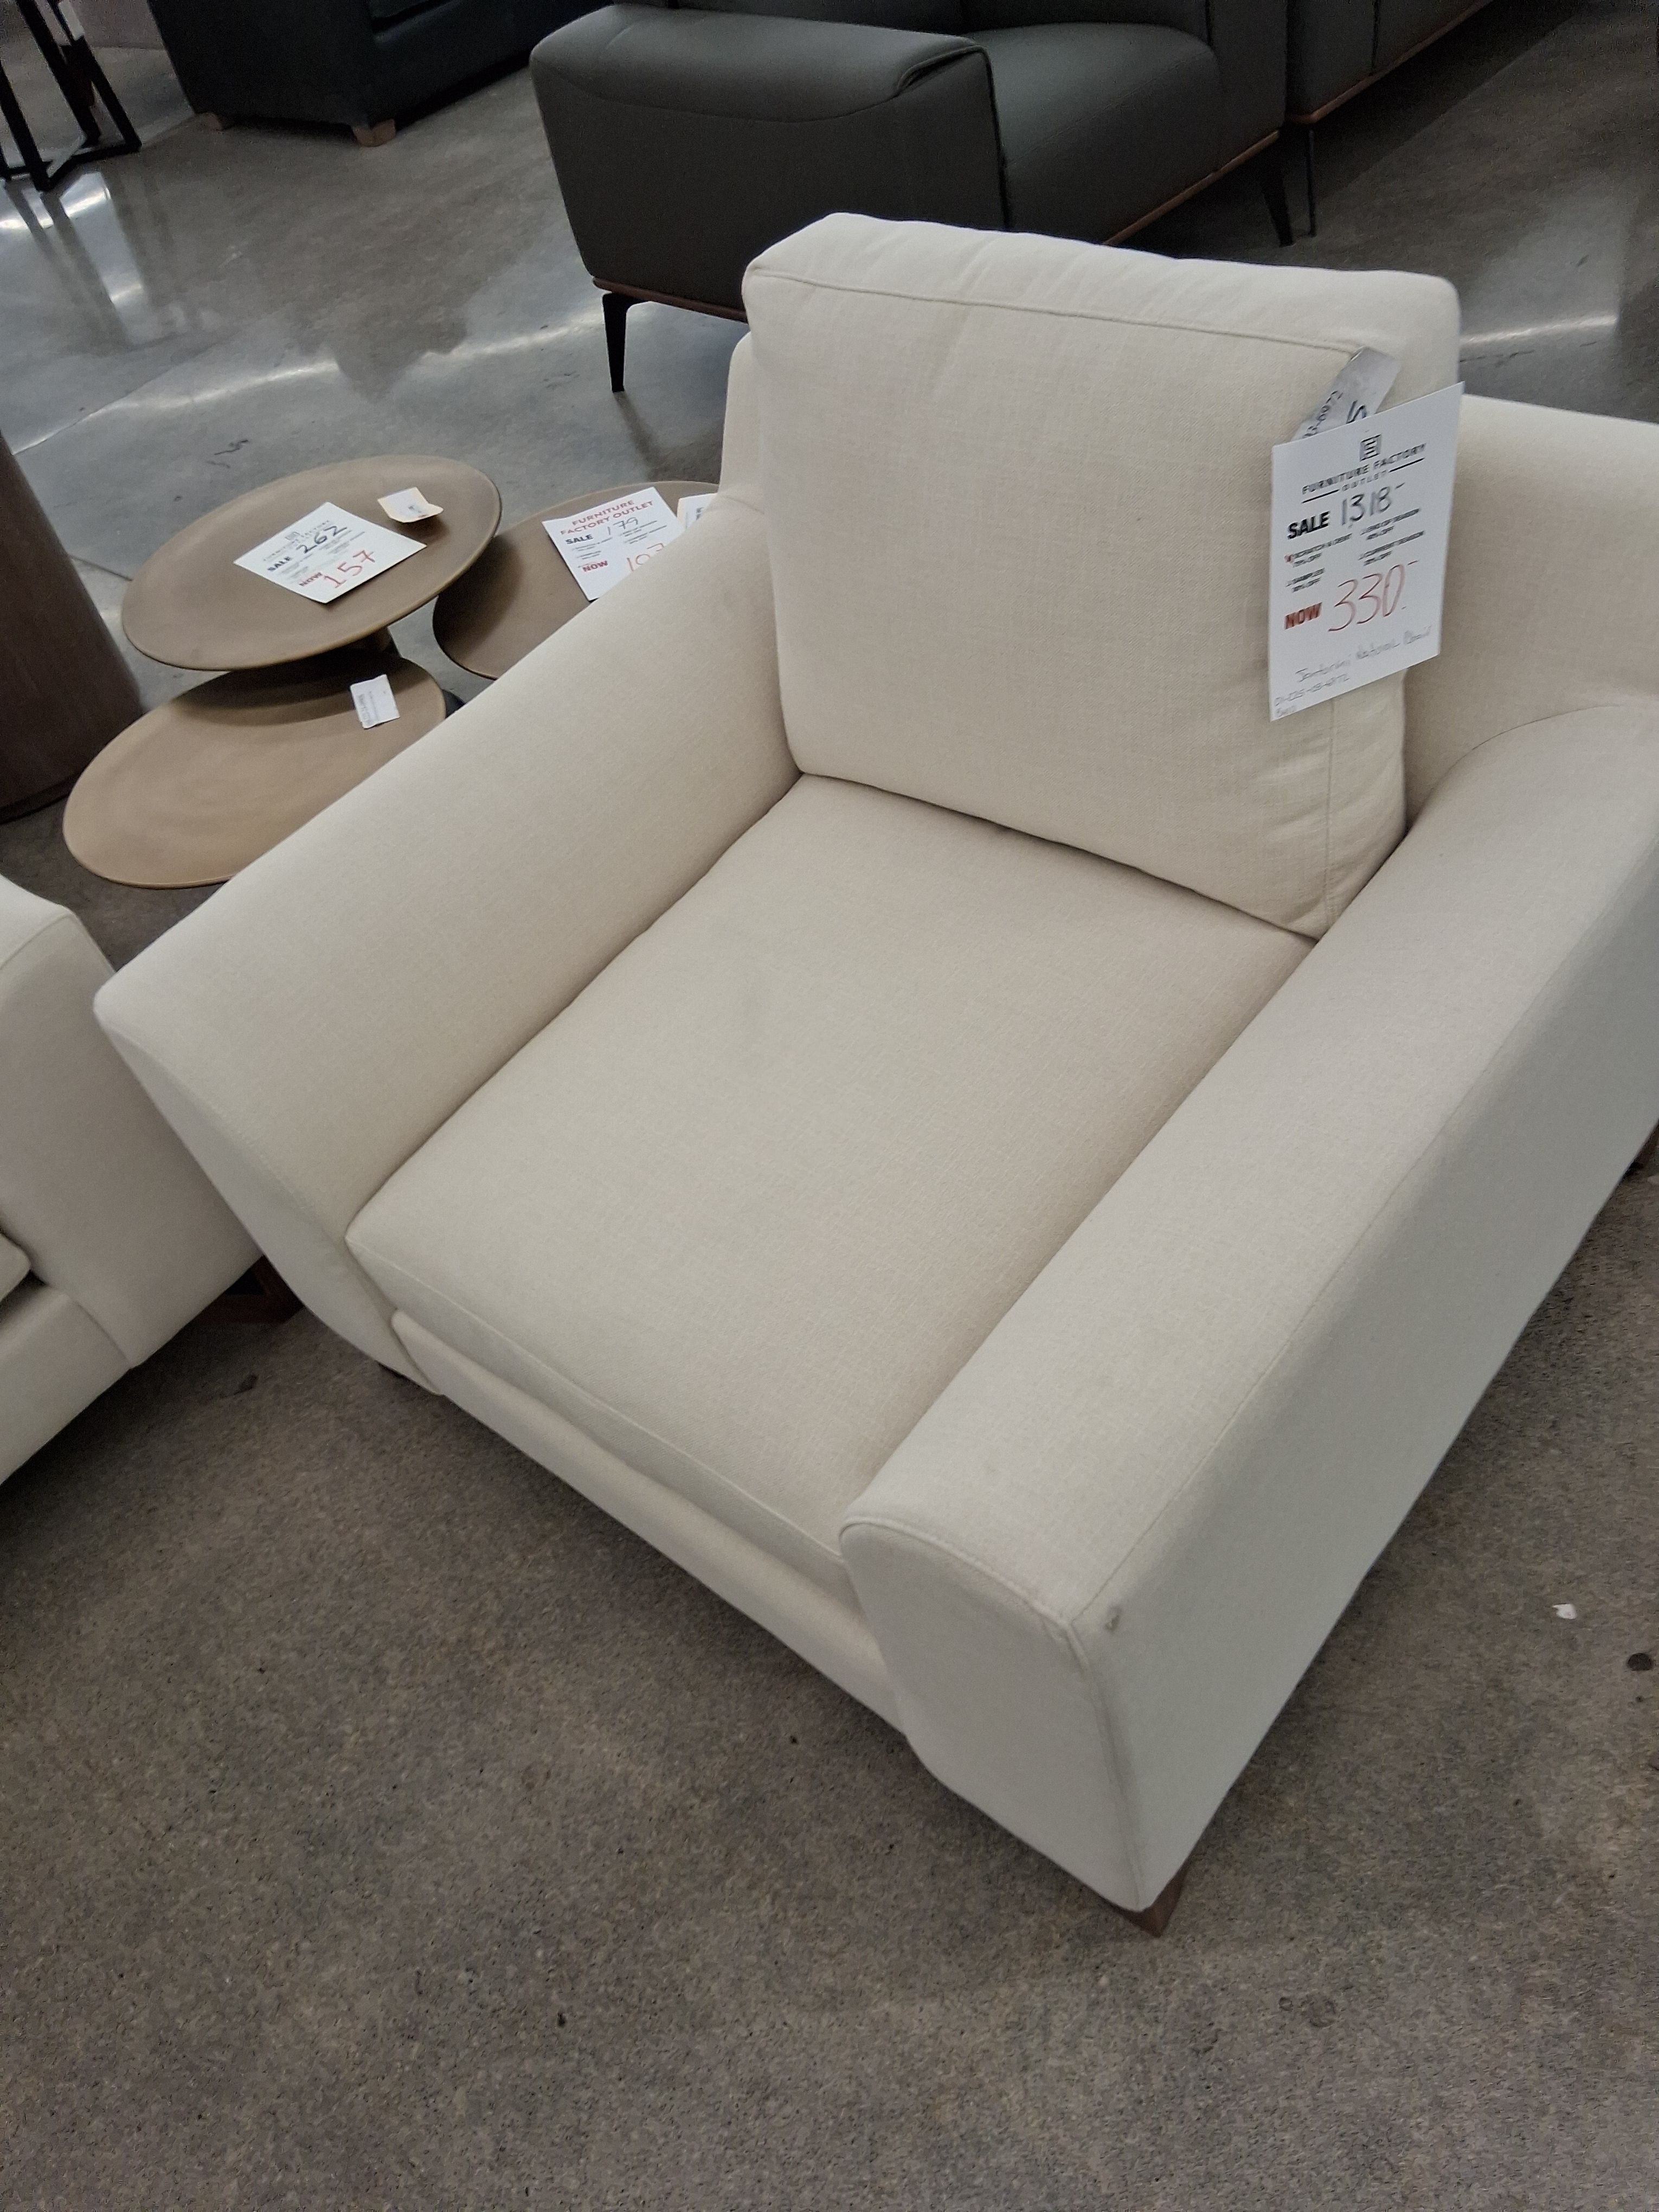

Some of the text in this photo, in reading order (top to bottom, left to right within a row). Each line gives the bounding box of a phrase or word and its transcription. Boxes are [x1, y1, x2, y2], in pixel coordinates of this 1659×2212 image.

[1302, 442, 1427, 494] FURNITURE FACTORY
[1342, 470, 1387, 491] OUTLET
[560, 517, 610, 535] FACTORY
[613, 500, 654, 518] OUTLET
[572, 500, 634, 525] FURNITURE
[1288, 511, 1330, 539] SALE
[565, 534, 594, 544] SALE
[607, 517, 639, 536] 179
[267, 556, 291, 571] SALE
[297, 525, 348, 554] 262
[324, 550, 376, 588] 157
[582, 560, 608, 573] NOW
[1284, 602, 1322, 630] NOW
